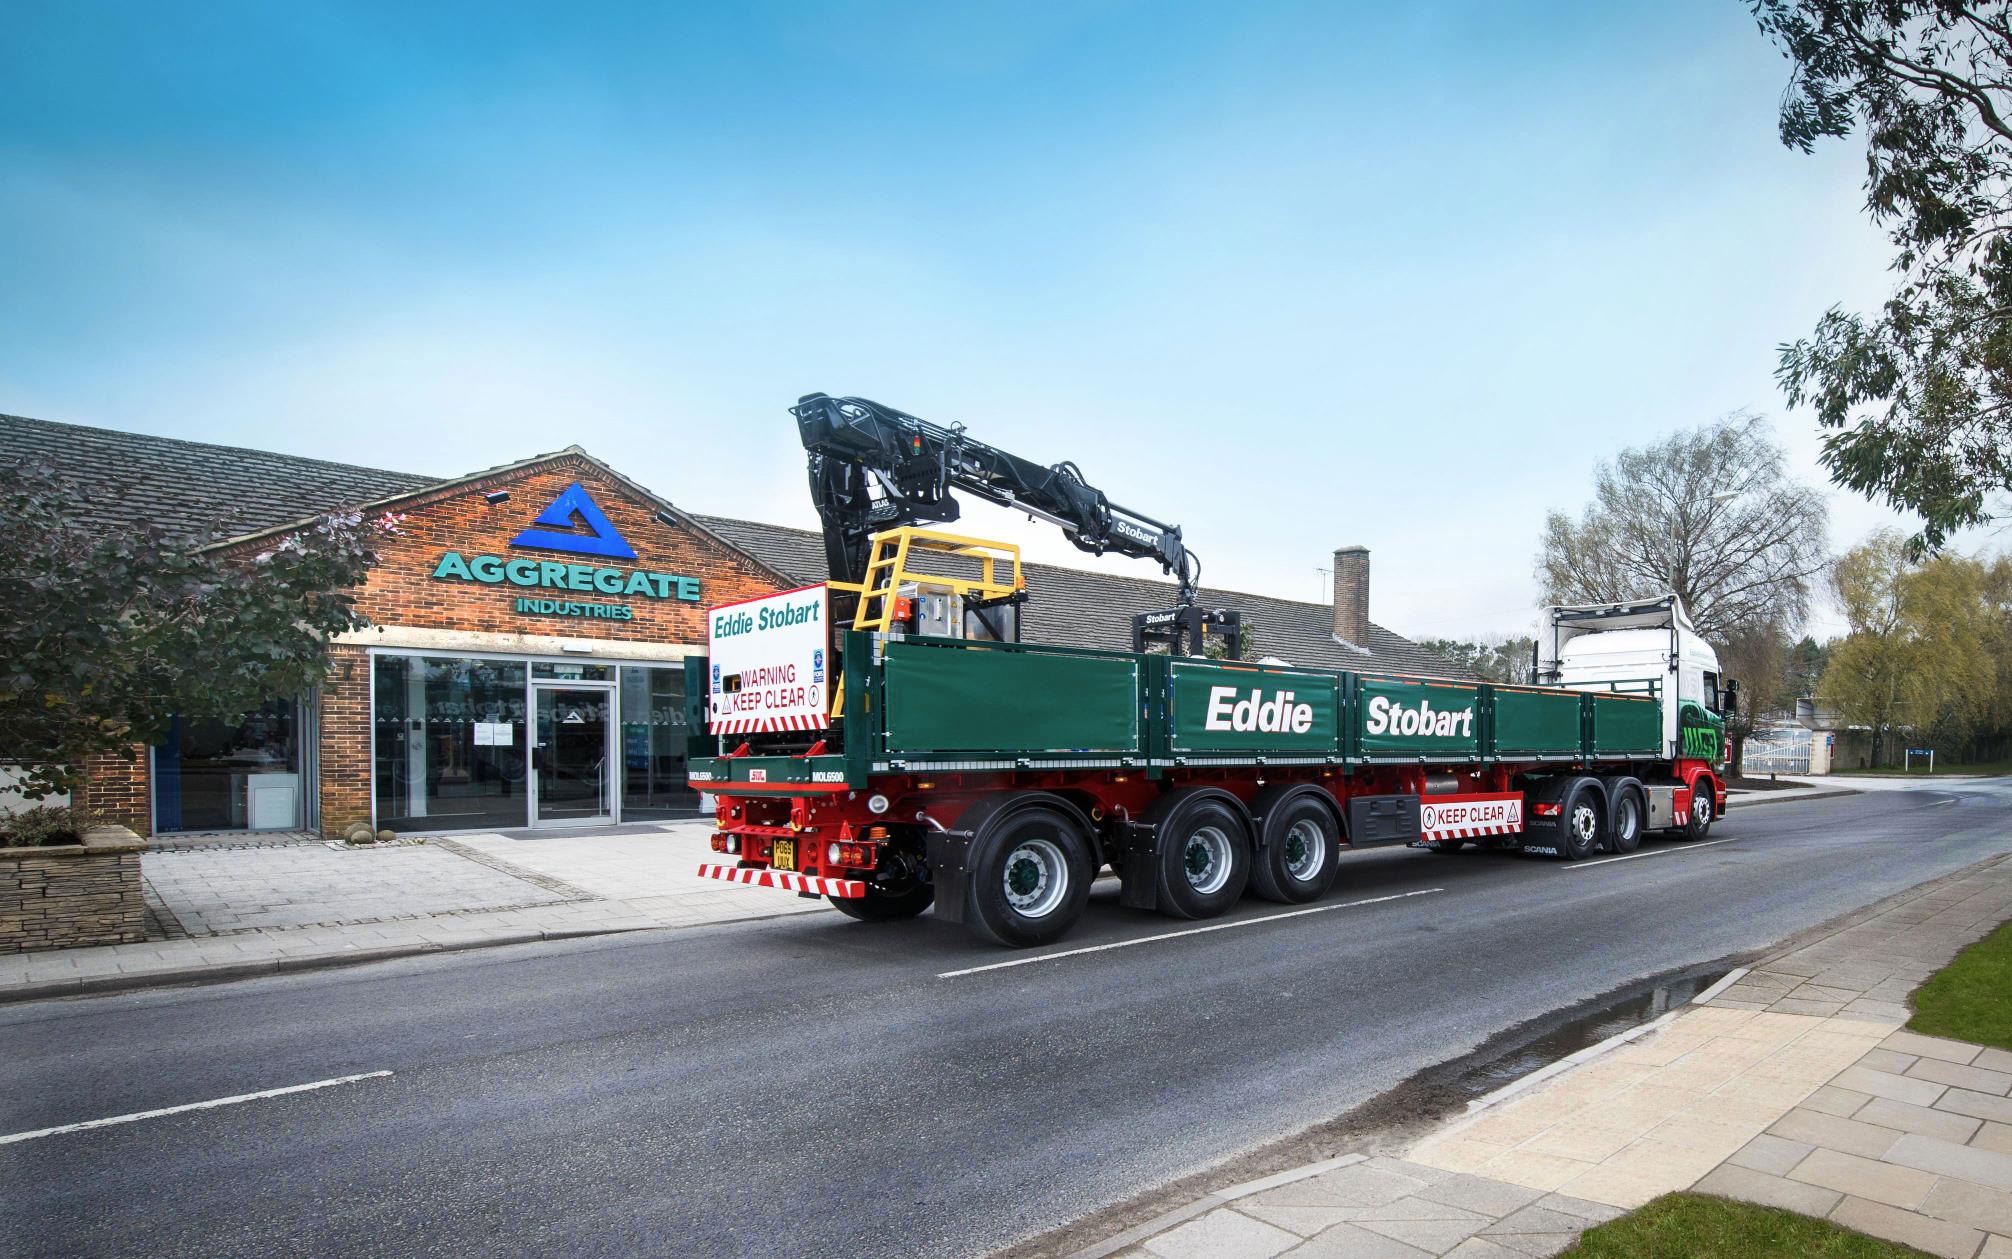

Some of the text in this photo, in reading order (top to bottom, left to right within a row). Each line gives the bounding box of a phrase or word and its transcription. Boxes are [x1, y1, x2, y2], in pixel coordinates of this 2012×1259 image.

[872, 499, 889, 509] ATLAS
[1117, 521, 1159, 546] Stobart
[432, 552, 700, 601] AGGREGATE
[516, 598, 633, 620] INDUSTRIES
[715, 600, 820, 638] Eddie Stobart
[1146, 612, 1176, 624] Stobart
[741, 664, 796, 688] WARNING
[733, 687, 805, 712] KEEP CLEAR
[1204, 686, 1473, 737] Eddie Stobart
[812, 771, 844, 782] MOL6500
[1438, 806, 1504, 824] KEEP CLEAR
[1524, 845, 1558, 855] SCANIA
